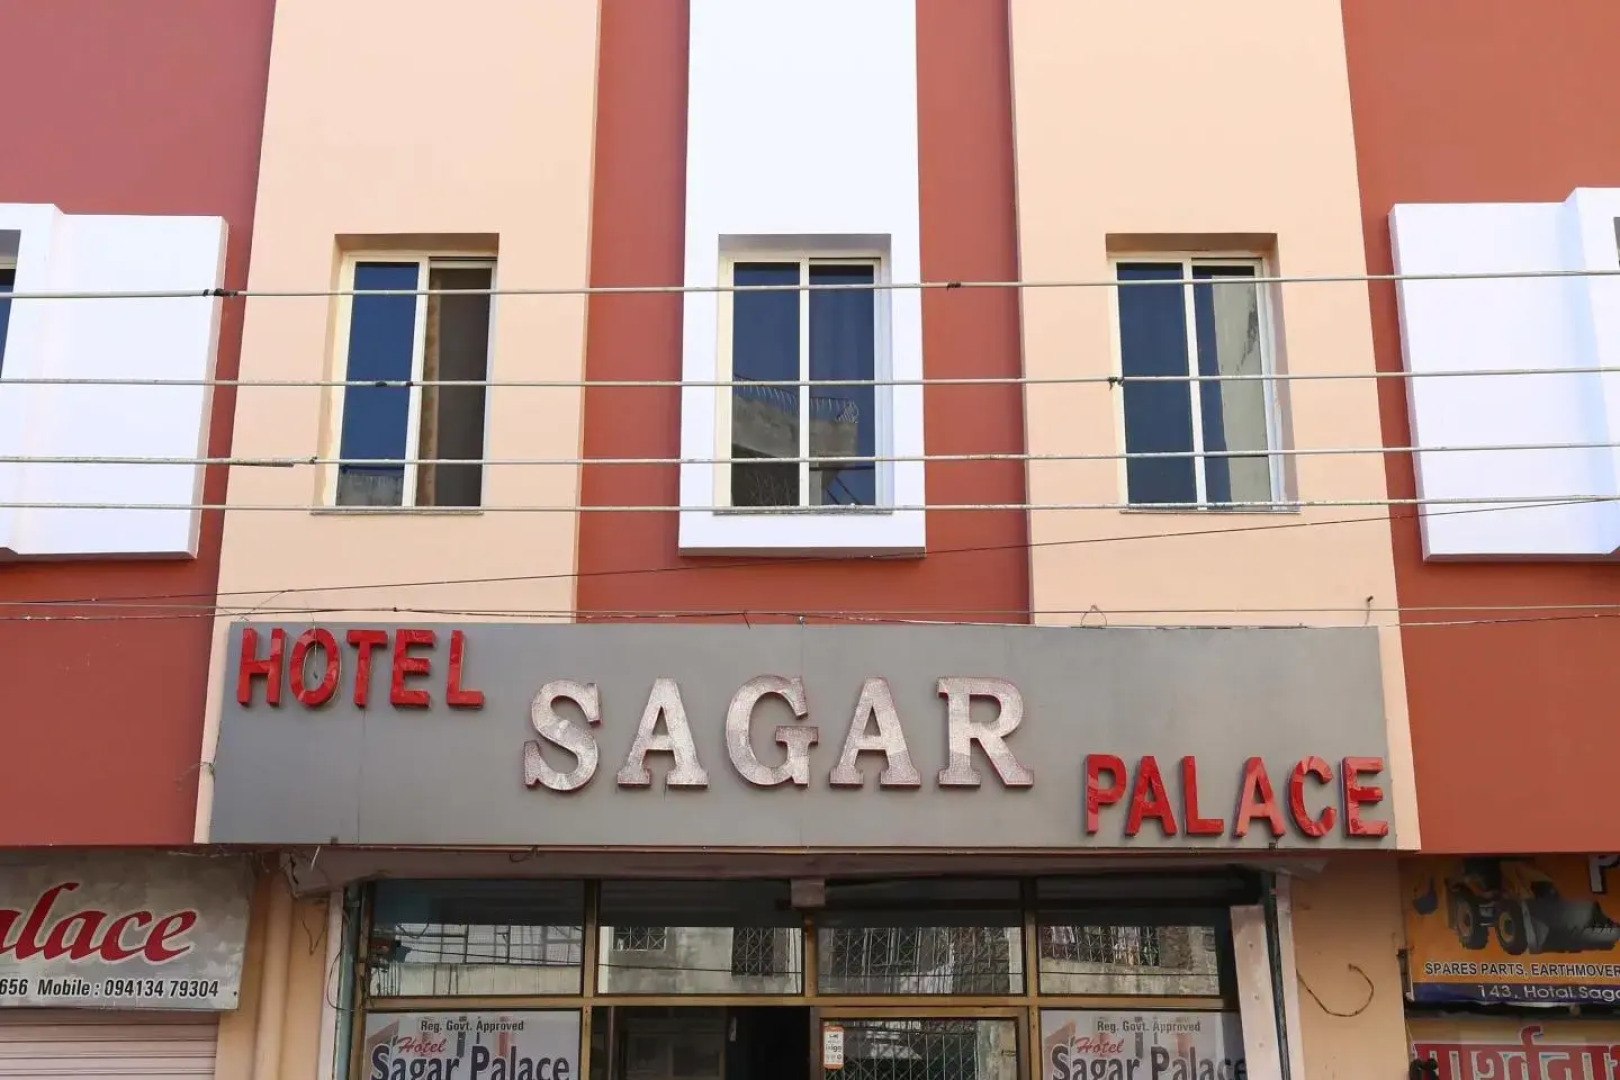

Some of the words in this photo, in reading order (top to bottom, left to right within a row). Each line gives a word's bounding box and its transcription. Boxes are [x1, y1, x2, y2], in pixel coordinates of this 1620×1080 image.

[236, 627, 485, 708] HOTEL
[522, 675, 1034, 792] SAGAR
[1083, 753, 1389, 838] PALACE
[1425, 962, 1477, 975] SPARES
[1531, 963, 1620, 978] EARTHMOVER
[37, 979, 91, 997] Mobile
[104, 979, 164, 997] 094134
[169, 980, 219, 997] 79304
[420, 1020, 443, 1034] Reg.
[446, 1020, 473, 1032] Govt.
[476, 1020, 524, 1034] Approved
[1097, 1020, 1119, 1034] Reg.
[1122, 1020, 1150, 1032] Govt.
[1153, 1021, 1201, 1034] Approved
[397, 1036, 447, 1053] Hotel
[1075, 1036, 1124, 1053] Hotel
[470, 1046, 570, 1080] Palace
